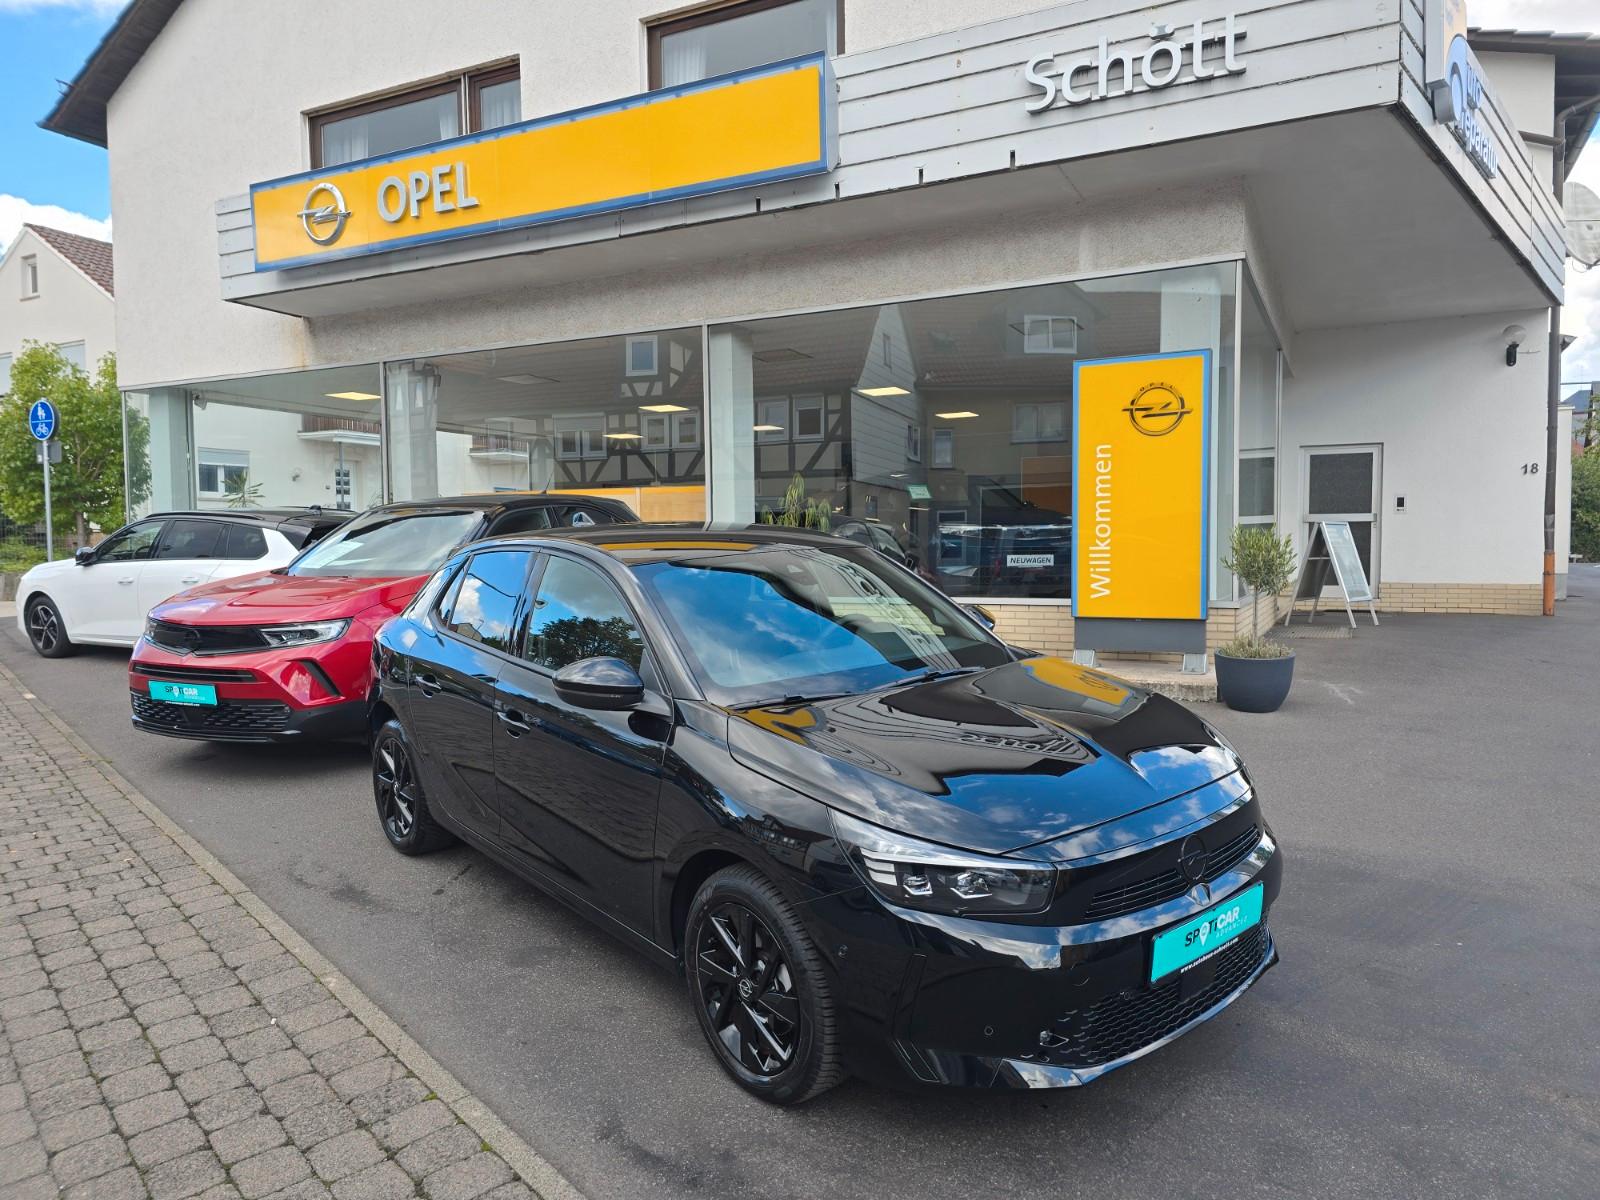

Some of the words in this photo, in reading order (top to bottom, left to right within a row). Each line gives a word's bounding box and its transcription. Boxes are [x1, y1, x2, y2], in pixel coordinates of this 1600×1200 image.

[1024, 13, 1248, 114] Schött
[377, 161, 480, 222] OPEL
[1520, 462, 1539, 475] 18
[1089, 444, 1112, 599] Willkommen
[1009, 556, 1052, 565] NEUWAGEN
